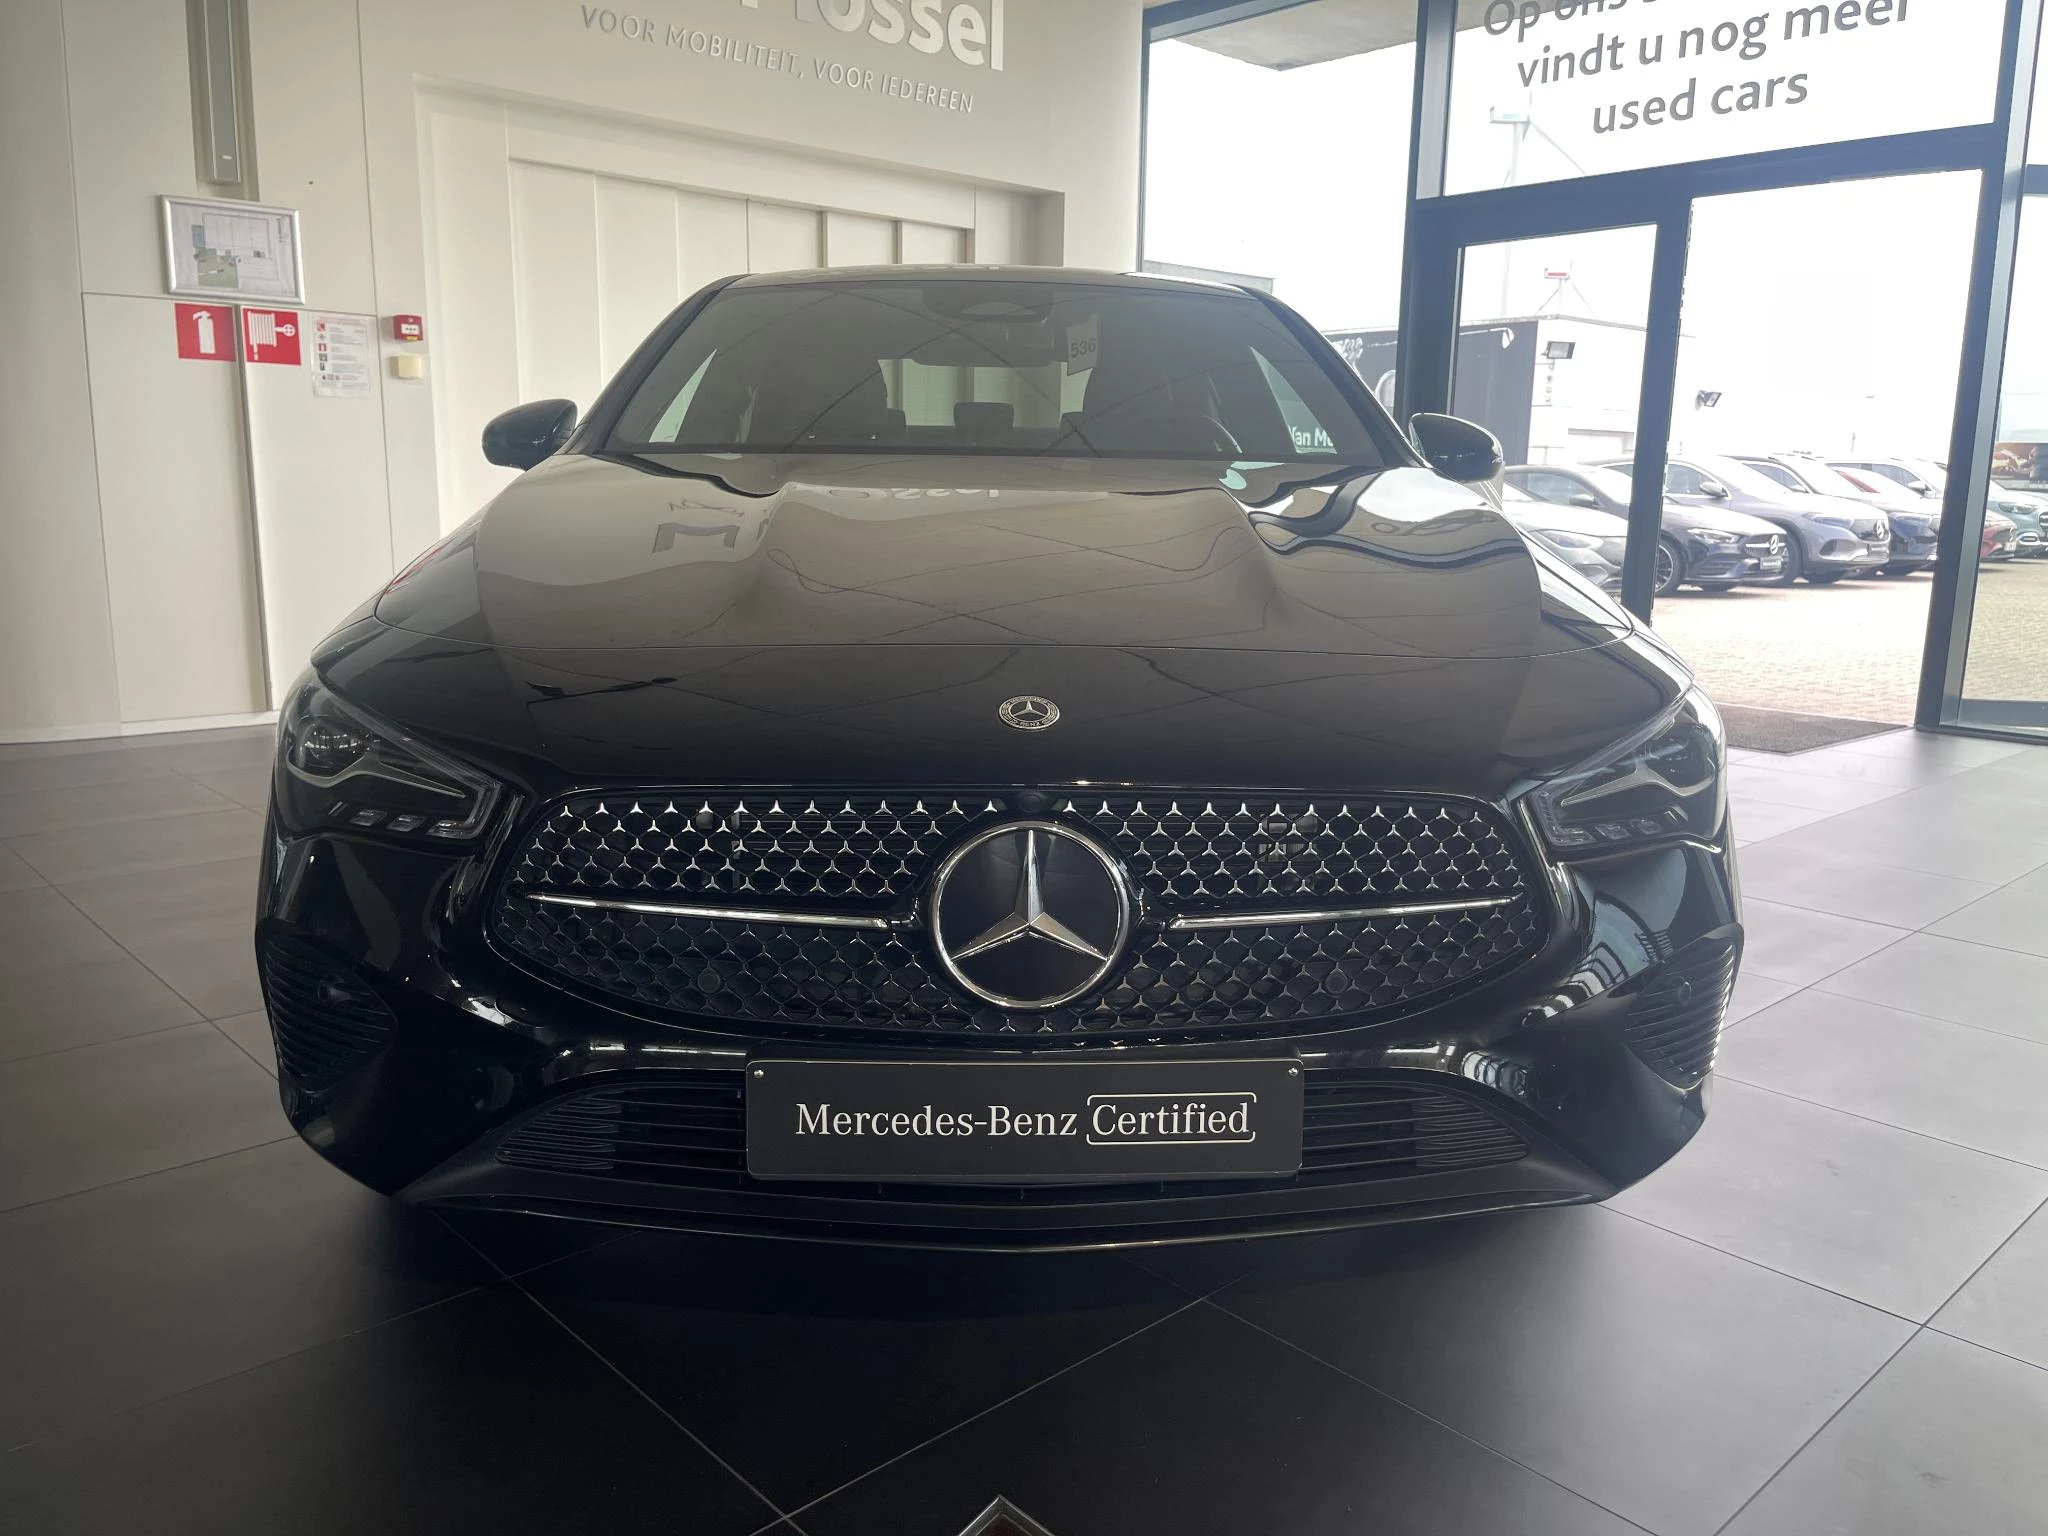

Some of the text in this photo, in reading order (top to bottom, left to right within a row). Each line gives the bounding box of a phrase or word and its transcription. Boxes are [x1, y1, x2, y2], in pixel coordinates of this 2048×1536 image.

[740, 0, 1003, 71] ossel
[1484, 0, 1541, 43] Op
[1517, 33, 1625, 87] vindt
[1638, 34, 1663, 65] u
[1678, 12, 1770, 60] nog
[581, 4, 973, 113] VOOR MOBILITEIT, VOOR IEDEREEN
[1592, 73, 1808, 134] used cars
[1070, 338, 1097, 358] 536
[794, 1102, 1250, 1137] Mercedes-Benz Certified
